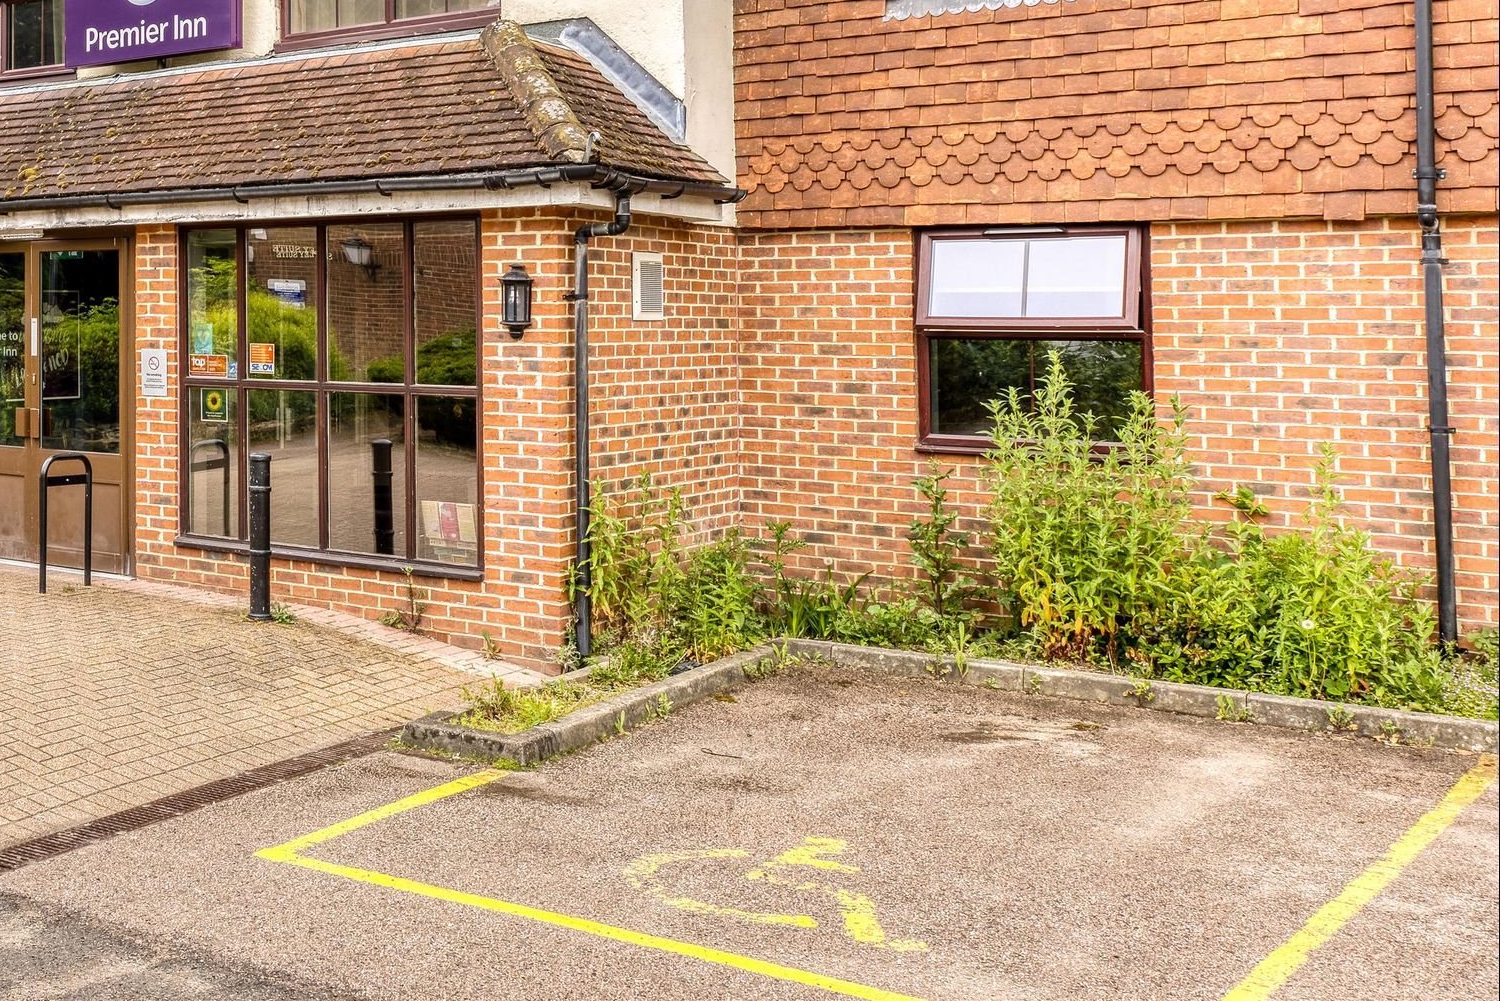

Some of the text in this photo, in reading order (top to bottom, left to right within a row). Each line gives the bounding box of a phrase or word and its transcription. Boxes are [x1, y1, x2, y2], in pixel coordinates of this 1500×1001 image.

[85, 14, 207, 53] Premier Inn
[8, 331, 19, 341] to
[3, 346, 18, 357] Inn
[191, 357, 206, 368] top
